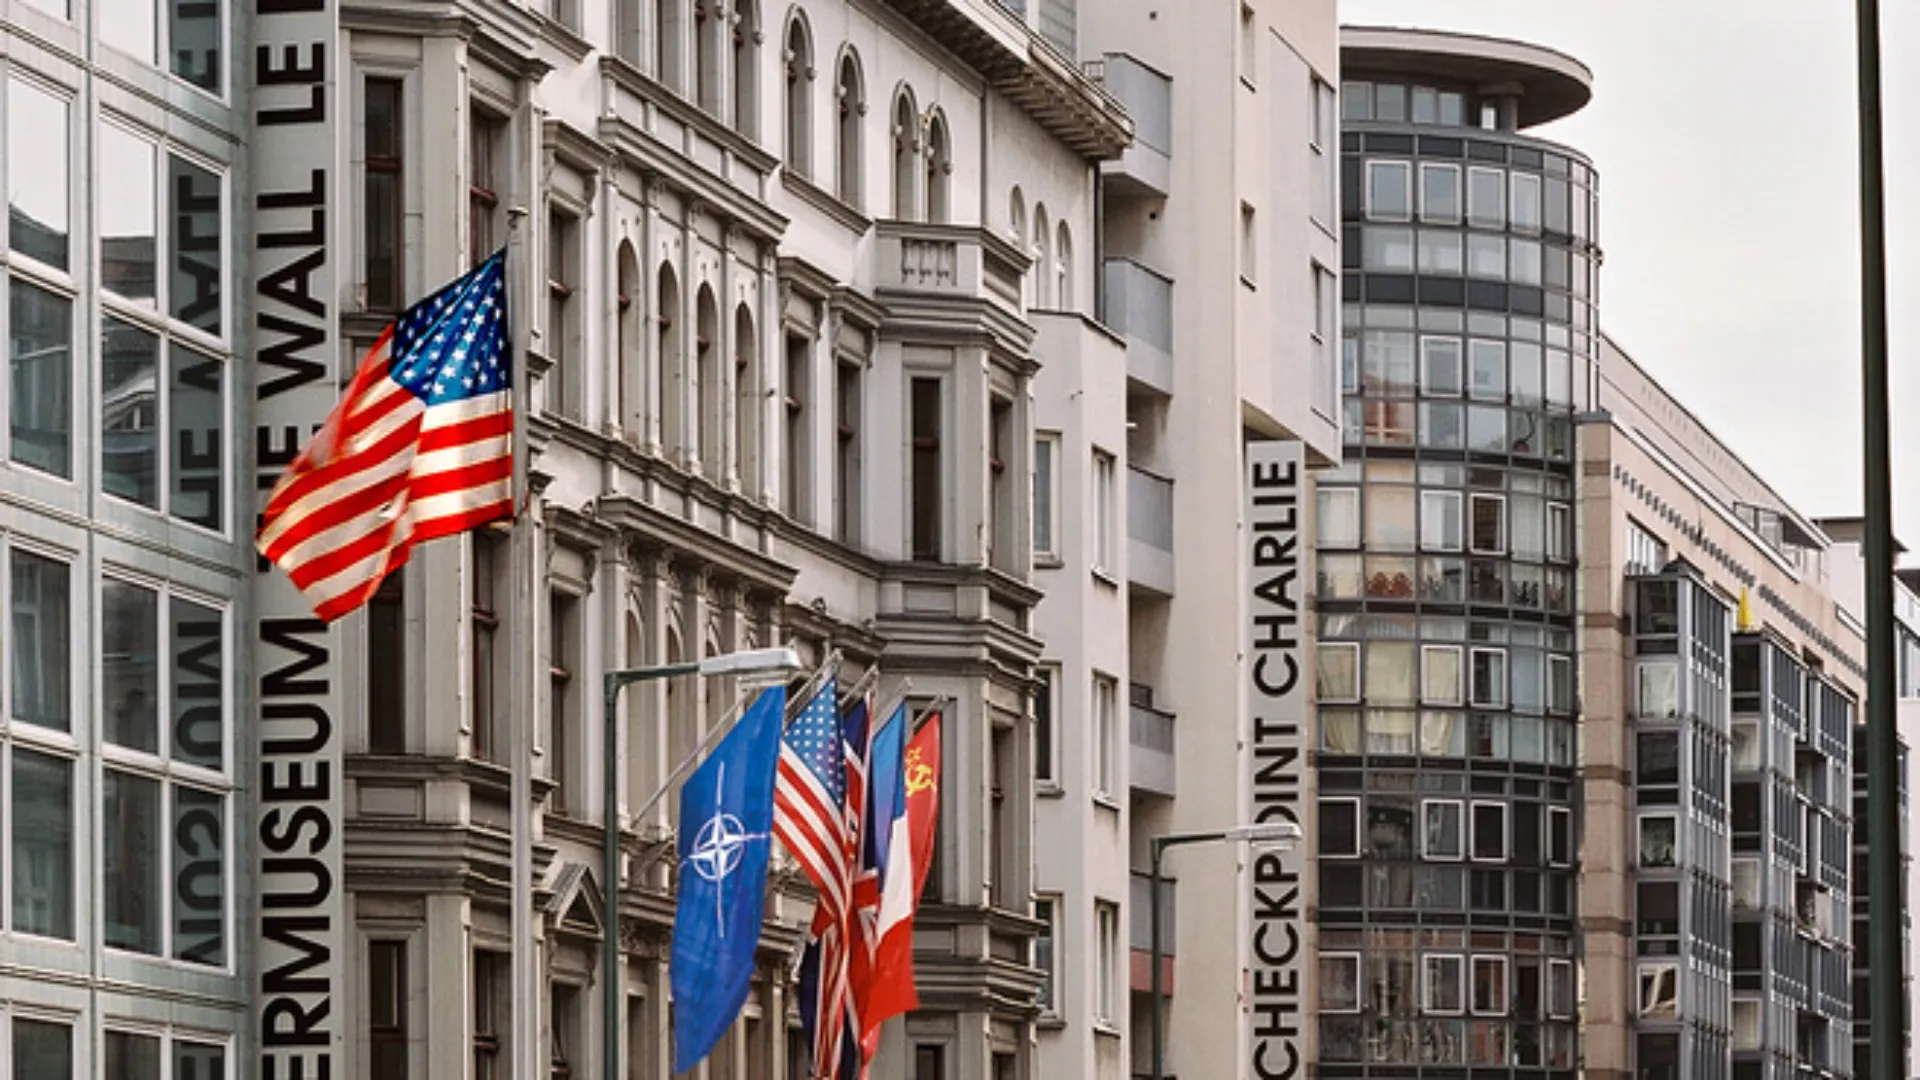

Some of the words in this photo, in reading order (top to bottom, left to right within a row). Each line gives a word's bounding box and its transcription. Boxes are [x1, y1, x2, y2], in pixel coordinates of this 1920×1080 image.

[256, 43, 325, 126] LE
[256, 169, 326, 401] WALL
[1253, 460, 1298, 697] CHARLIE
